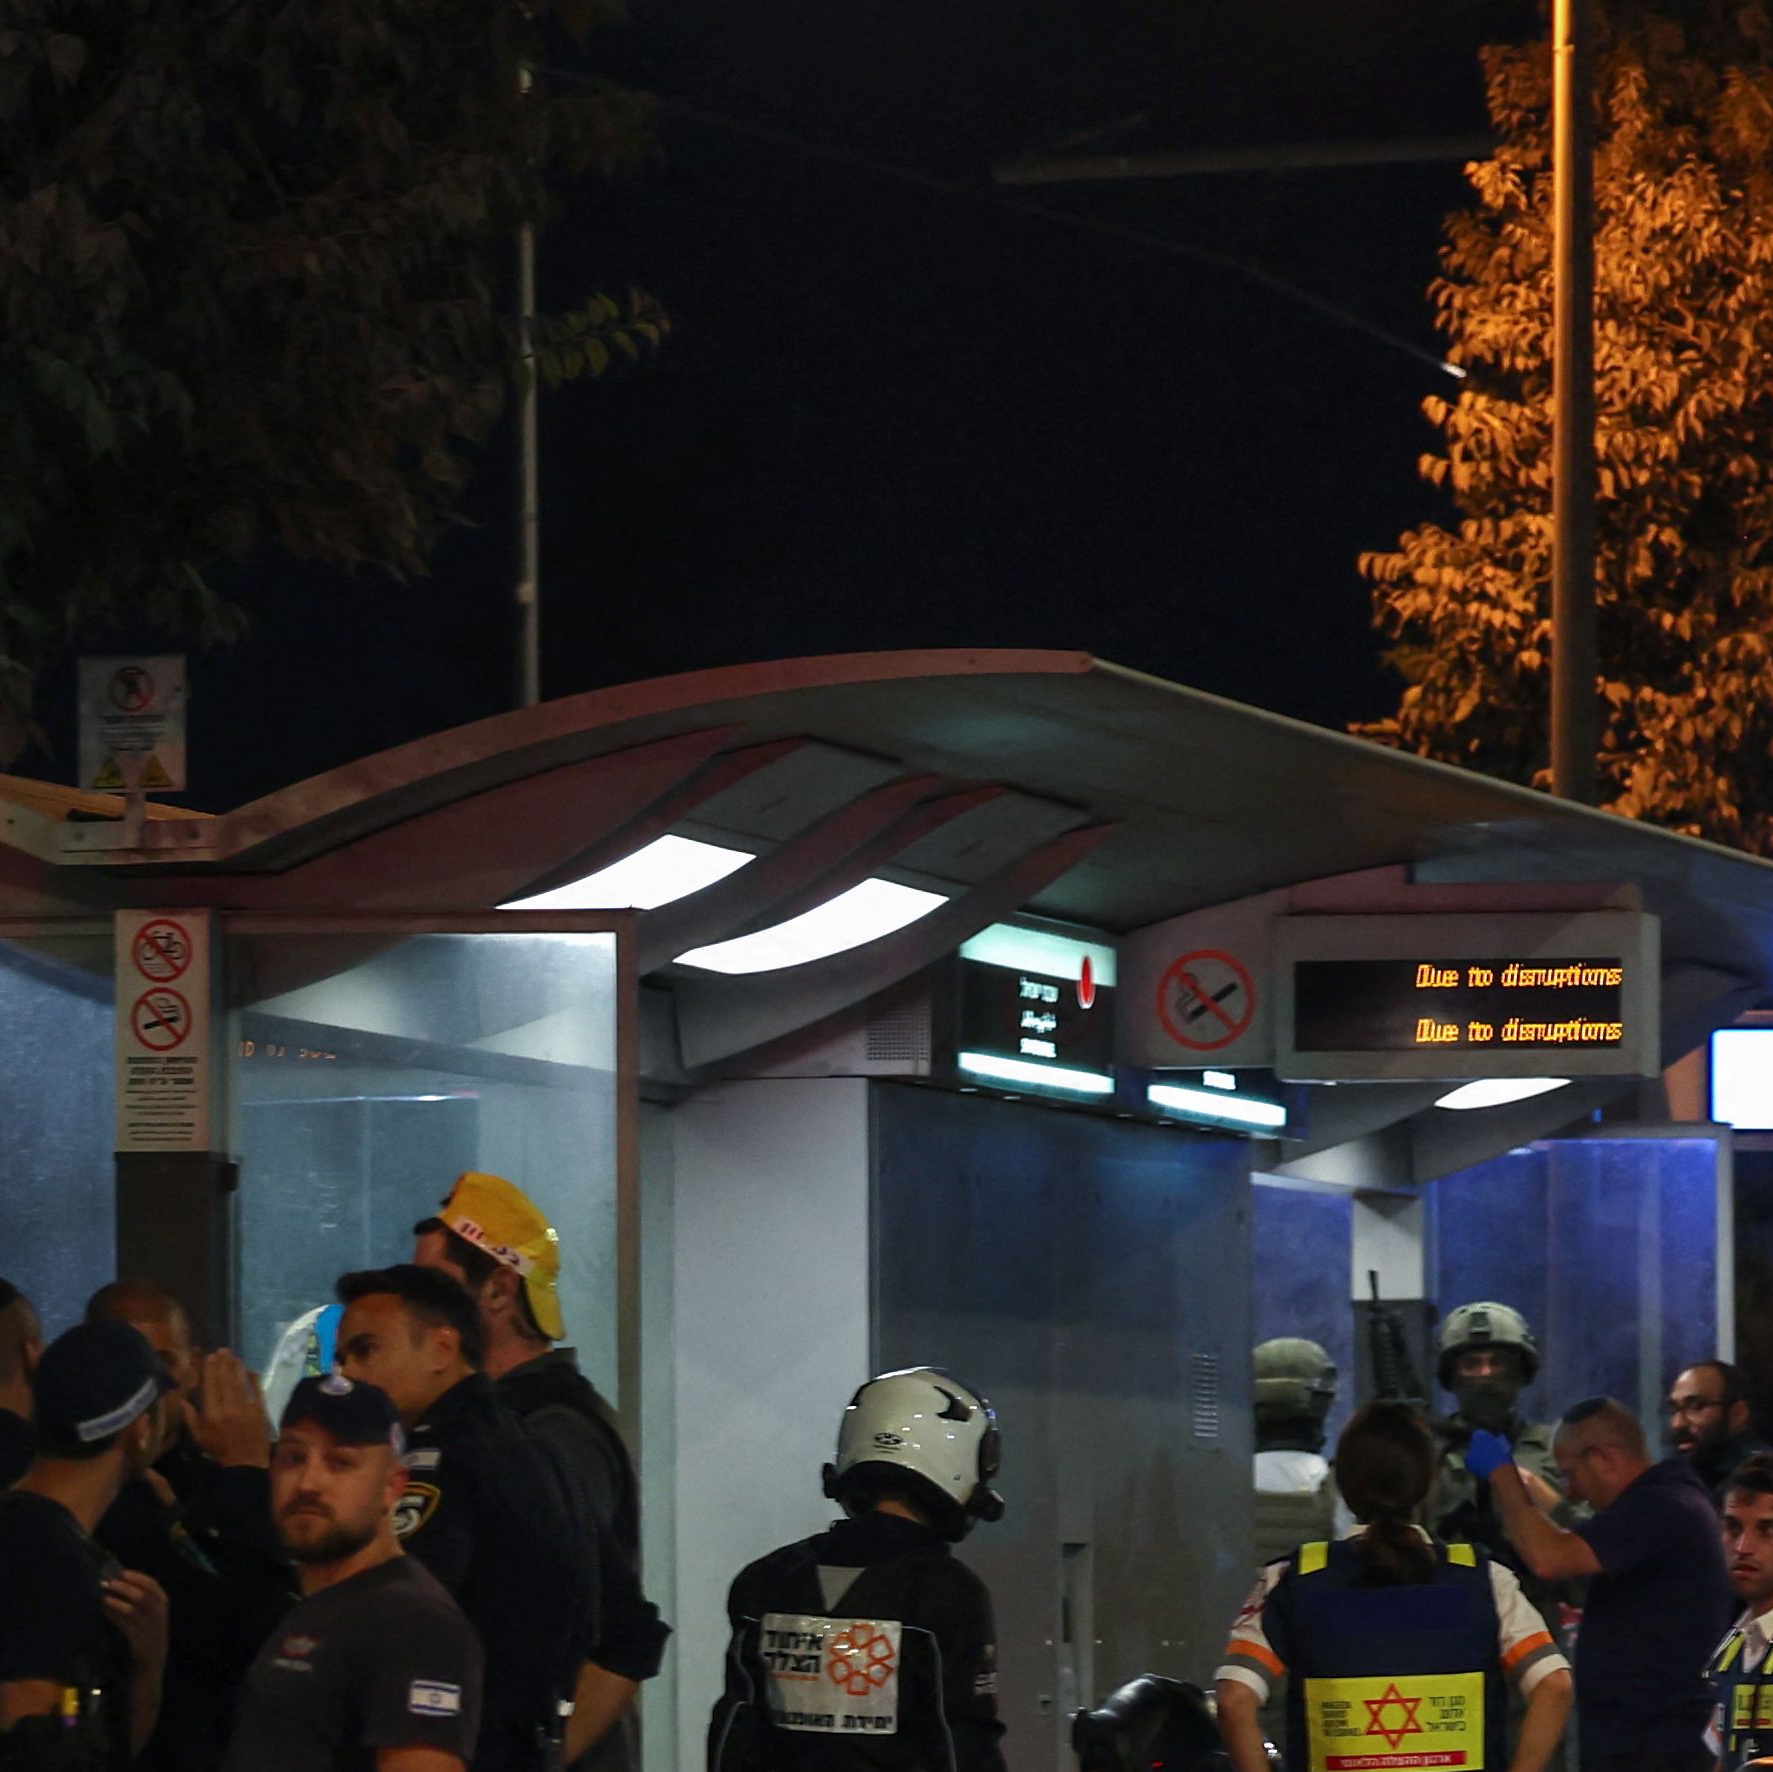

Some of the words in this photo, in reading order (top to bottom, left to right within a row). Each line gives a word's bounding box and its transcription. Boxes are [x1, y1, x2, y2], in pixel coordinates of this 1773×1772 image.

[1415, 963, 1460, 988] Due
[1467, 966, 1494, 988] to
[1500, 962, 1624, 989] disruptions
[1415, 1017, 1460, 1043] Due
[1467, 1020, 1494, 1043] to
[1500, 1016, 1624, 1043] disruptions
